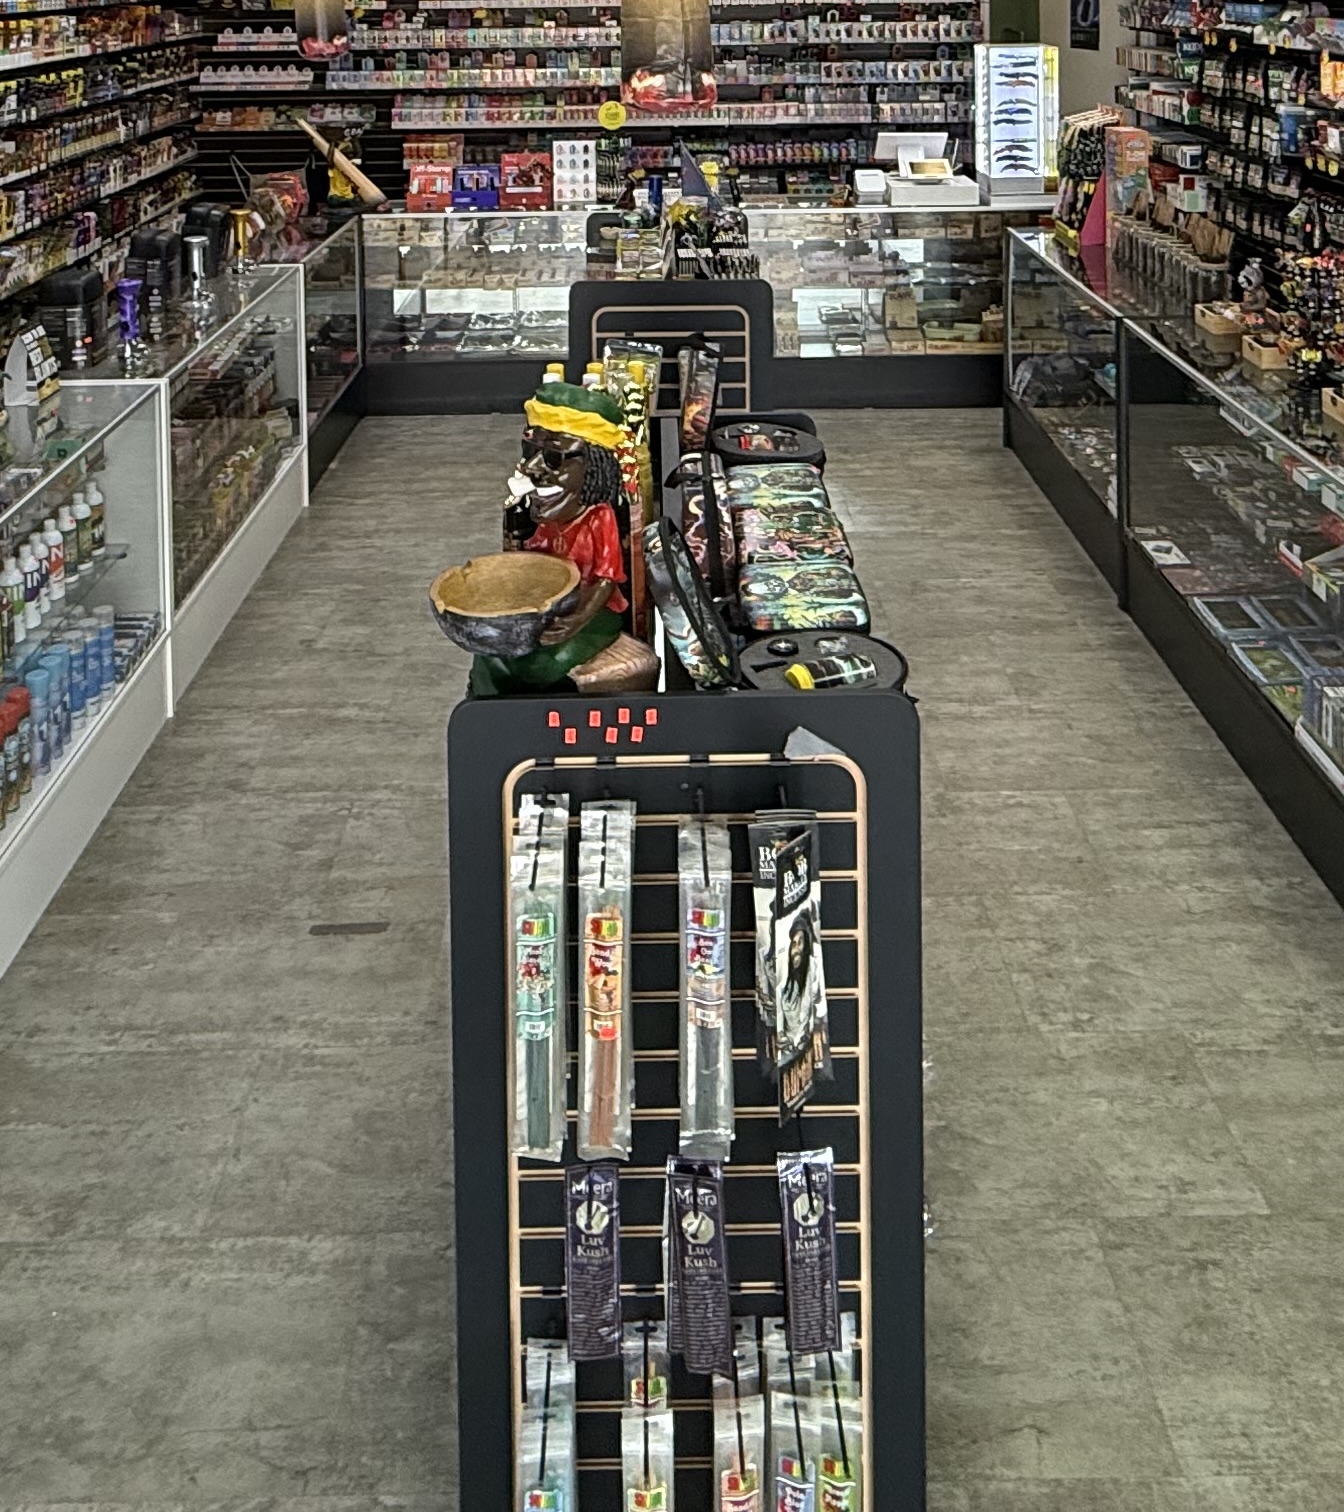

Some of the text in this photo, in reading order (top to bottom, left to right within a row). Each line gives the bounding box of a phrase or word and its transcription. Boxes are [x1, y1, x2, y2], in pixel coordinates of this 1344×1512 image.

[787, 1172, 828, 1189] Mera
[572, 1179, 613, 1196] Mera
[676, 1190, 717, 1207] Mera
[798, 1227, 821, 1238] Luv
[581, 1234, 605, 1246] Luv
[795, 1236, 827, 1252] Kush
[576, 1245, 609, 1258] Kush
[687, 1244, 713, 1256] Luv
[684, 1256, 717, 1268] Kush
